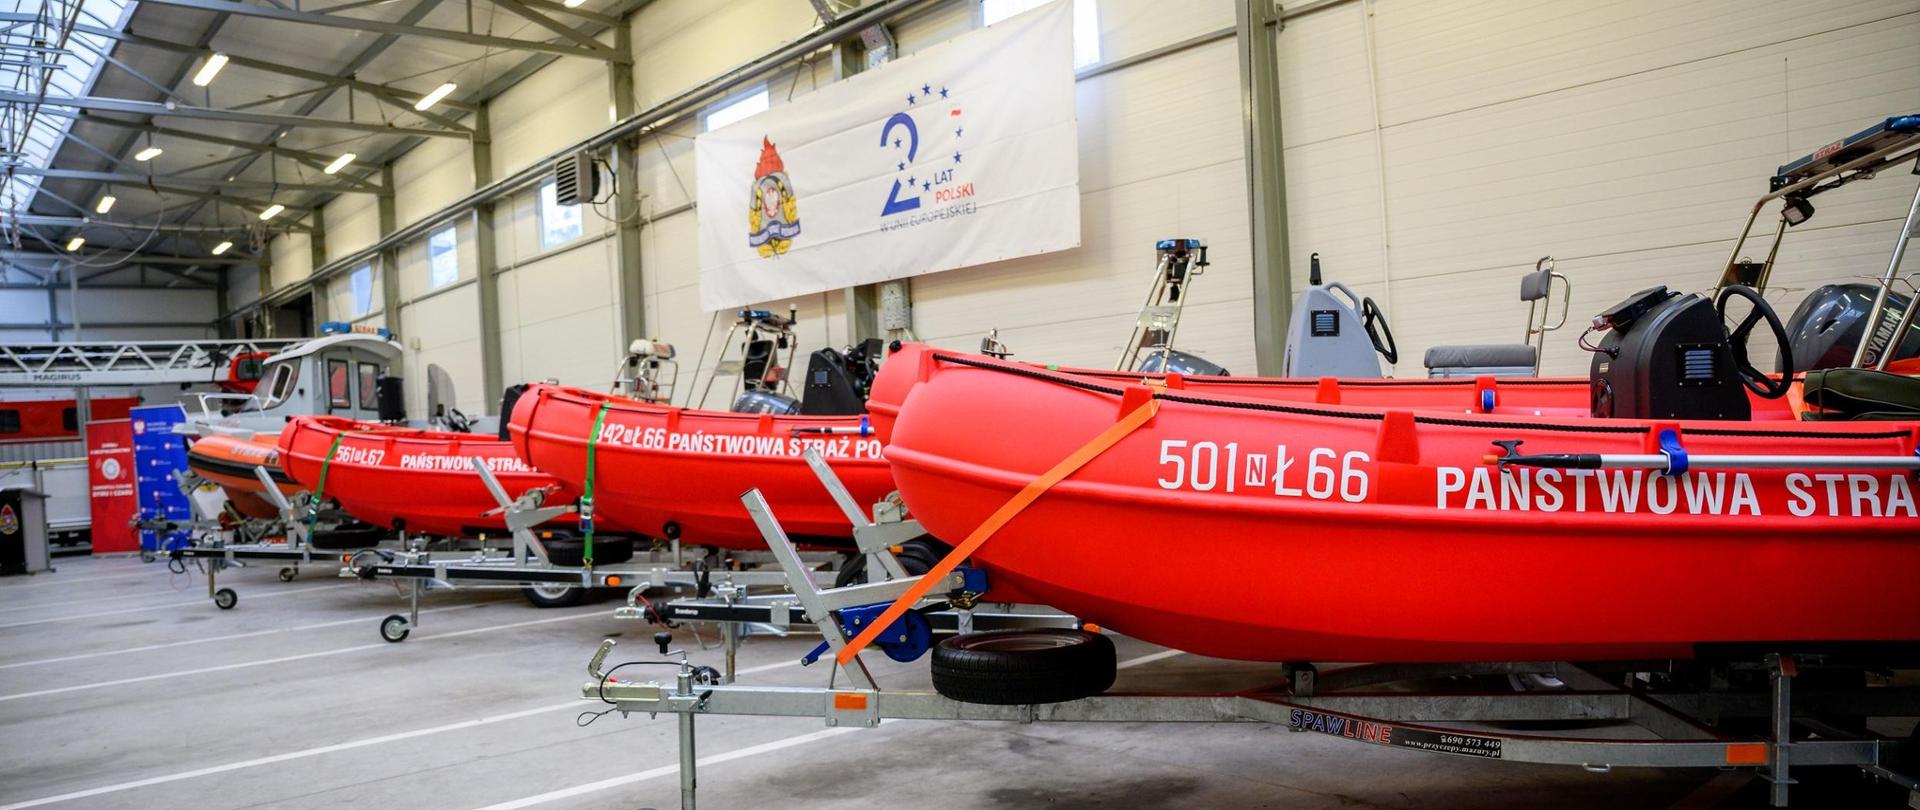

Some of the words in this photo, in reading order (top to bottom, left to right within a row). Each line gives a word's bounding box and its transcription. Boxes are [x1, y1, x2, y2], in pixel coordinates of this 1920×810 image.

[934, 169, 953, 184] LAT
[936, 183, 975, 204] POLSKI
[1868, 307, 1903, 352] YAMAHA
[668, 430, 784, 457] PAŃSTWOWA
[789, 436, 850, 459] STRAŻ
[855, 439, 886, 460] PO
[1290, 710, 1393, 744] SPAWLINE
[1447, 735, 1464, 745] 690
[1465, 738, 1481, 747] 573
[1484, 740, 1501, 749] 449
